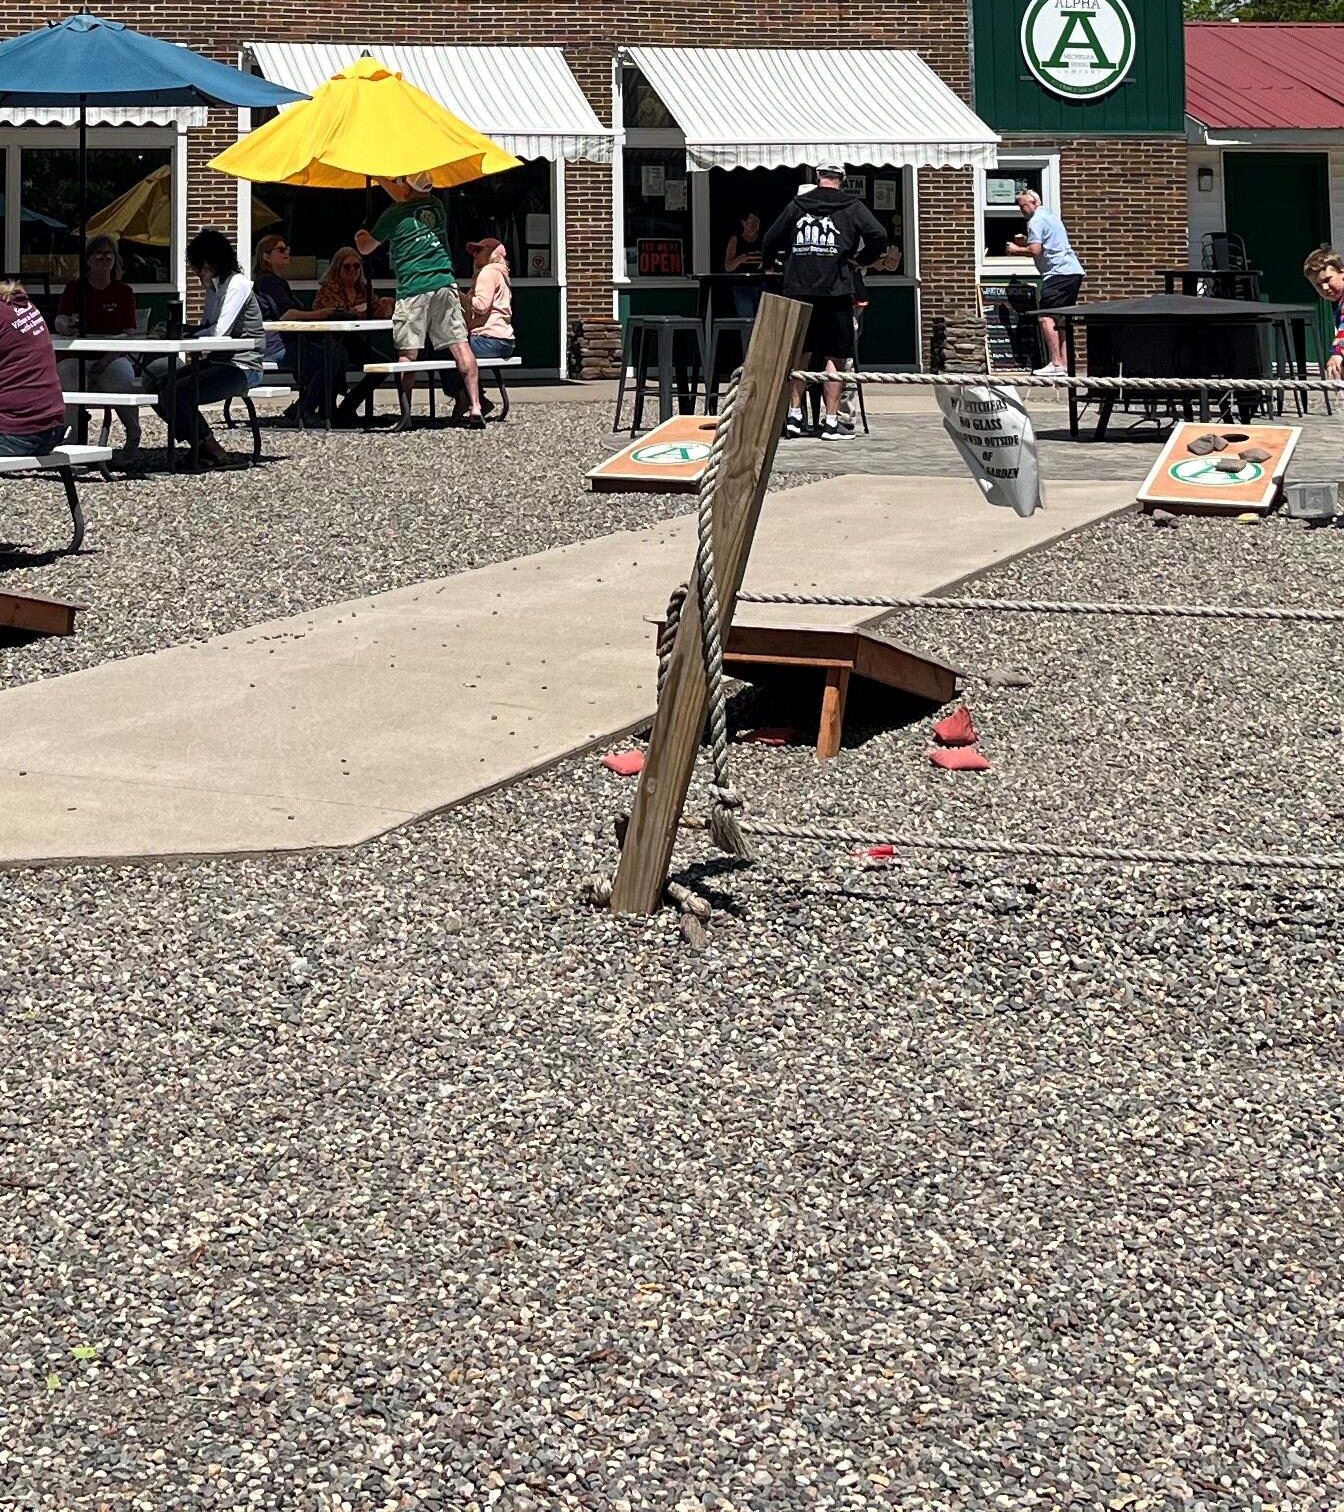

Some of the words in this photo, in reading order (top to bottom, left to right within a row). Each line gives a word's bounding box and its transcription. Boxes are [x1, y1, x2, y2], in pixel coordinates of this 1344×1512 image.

[1040, 10, 1117, 70] A
[639, 253, 681, 273] OPEN
[972, 418, 1003, 431] GLASS
[984, 434, 1020, 448] OUTSIDE
[982, 450, 993, 462] OF
